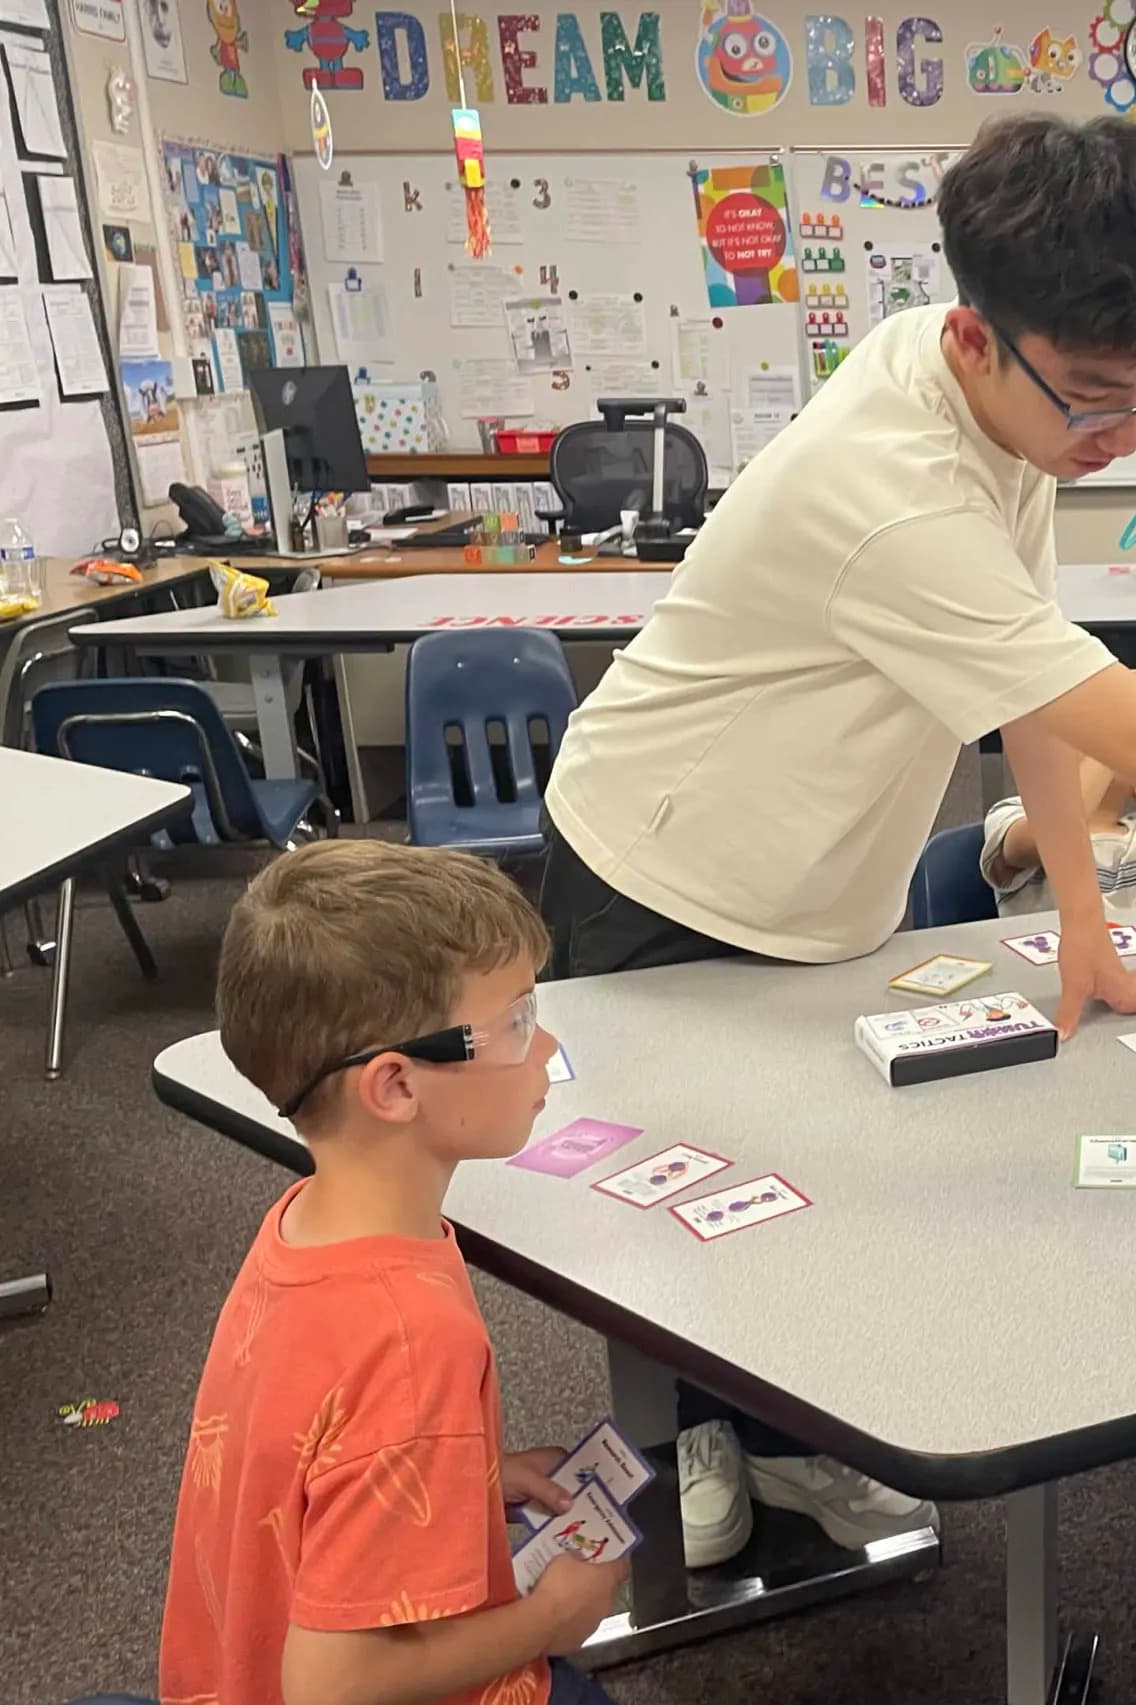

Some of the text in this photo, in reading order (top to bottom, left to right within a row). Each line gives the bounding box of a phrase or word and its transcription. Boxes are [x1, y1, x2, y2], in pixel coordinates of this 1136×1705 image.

[375, 11, 944, 107] DREAM BIG
[532, 178, 551, 209] 3
[724, 208, 762, 219] IT'S OKAY
[716, 224, 726, 233] TO
[728, 223, 745, 232] NOT
[712, 239, 726, 248] BUT
[742, 236, 759, 245] NOT
[761, 234, 782, 243] OKAY
[724, 250, 735, 260] TO
[737, 249, 755, 259] NOT
[540, 265, 560, 295] 4
[897, 1033, 966, 1051] TACTICS
